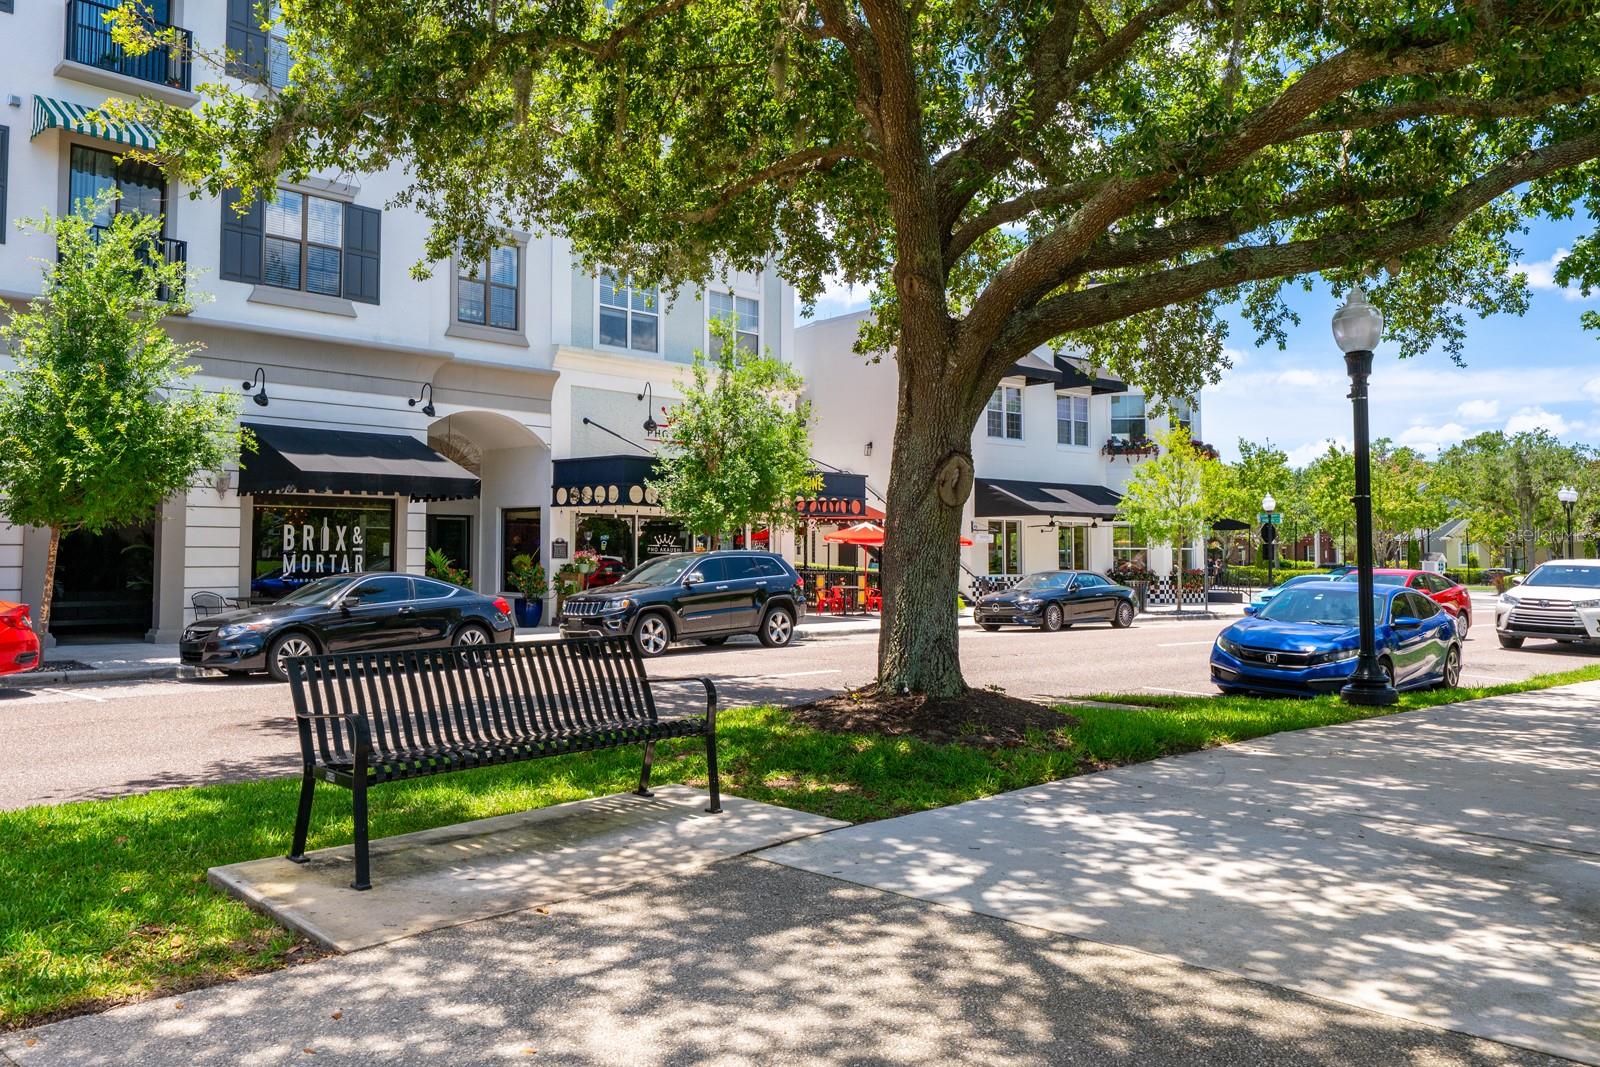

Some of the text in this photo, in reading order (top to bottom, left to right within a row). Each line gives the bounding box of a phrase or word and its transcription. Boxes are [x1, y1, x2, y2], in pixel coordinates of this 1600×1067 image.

[283, 517, 363, 551] BRIX &
[282, 554, 363, 573] MORTAR
